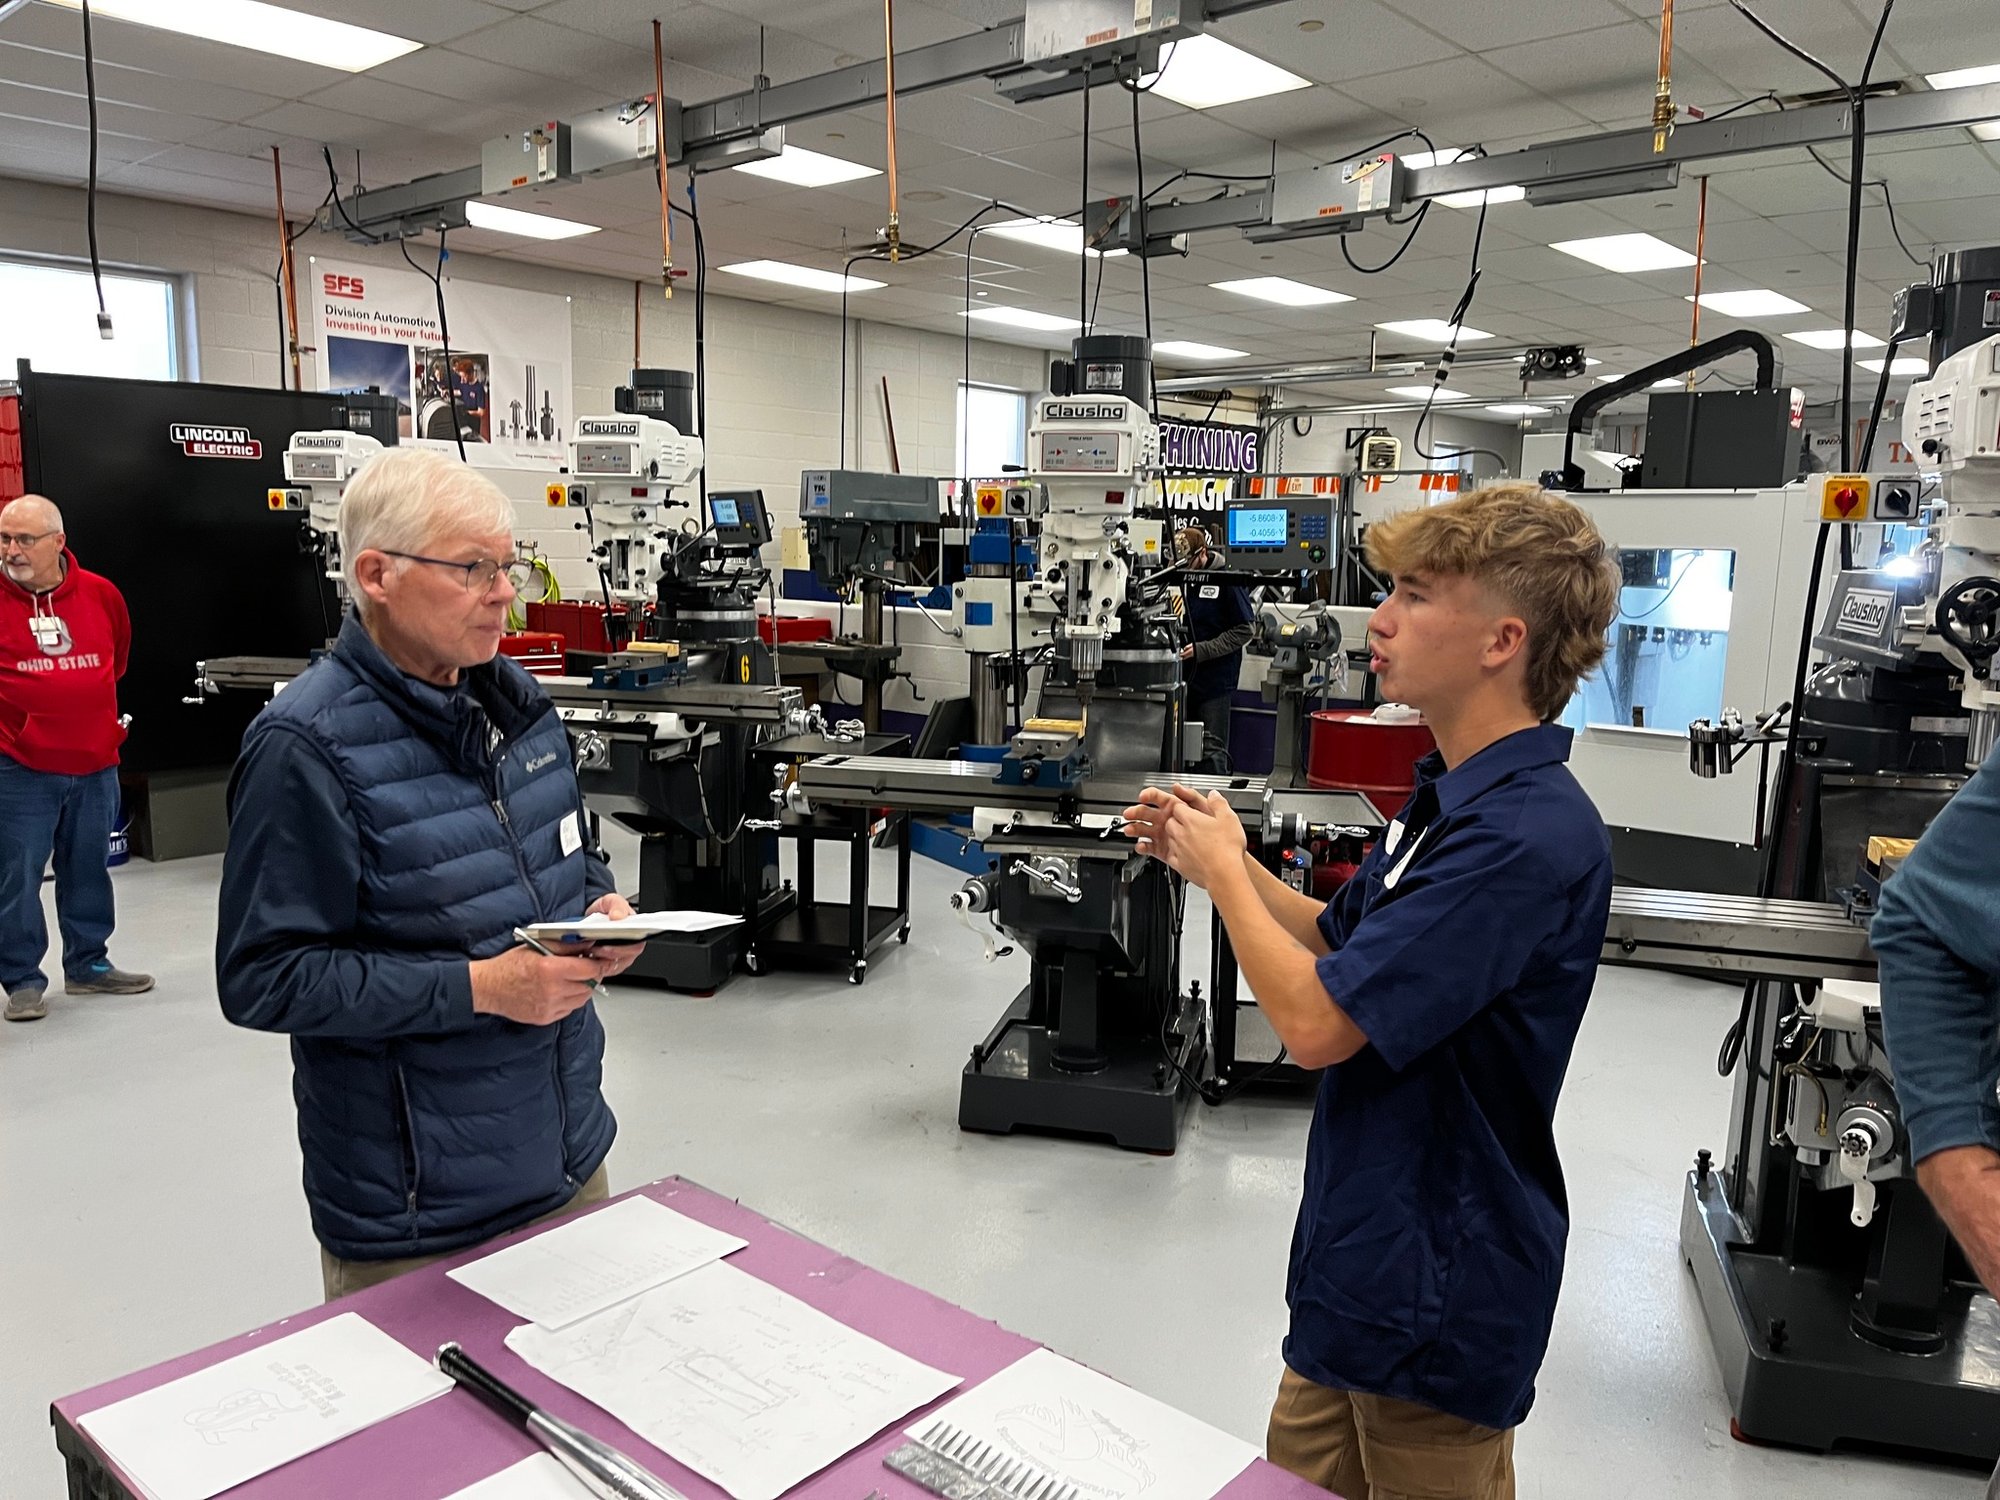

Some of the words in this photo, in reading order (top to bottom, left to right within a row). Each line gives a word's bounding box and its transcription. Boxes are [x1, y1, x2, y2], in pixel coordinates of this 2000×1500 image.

[324, 273, 364, 294] SFS
[325, 304, 370, 320] Division
[373, 311, 436, 329] Automotive
[326, 318, 377, 335] Investing
[380, 325, 391, 336] in
[394, 328, 417, 339] your
[1046, 404, 1123, 419] Clausing
[175, 427, 245, 444] LINCOLN
[582, 422, 637, 434] Clausing
[193, 443, 254, 456] ELECTRIC
[297, 436, 341, 448] Clausing
[1279, 513, 1285, 521] X
[1279, 529, 1285, 537] Y
[1842, 594, 1886, 623] Clausing
[17, 657, 54, 672] OHIO
[58, 653, 100, 670] STATE
[740, 654, 750, 684] 6
